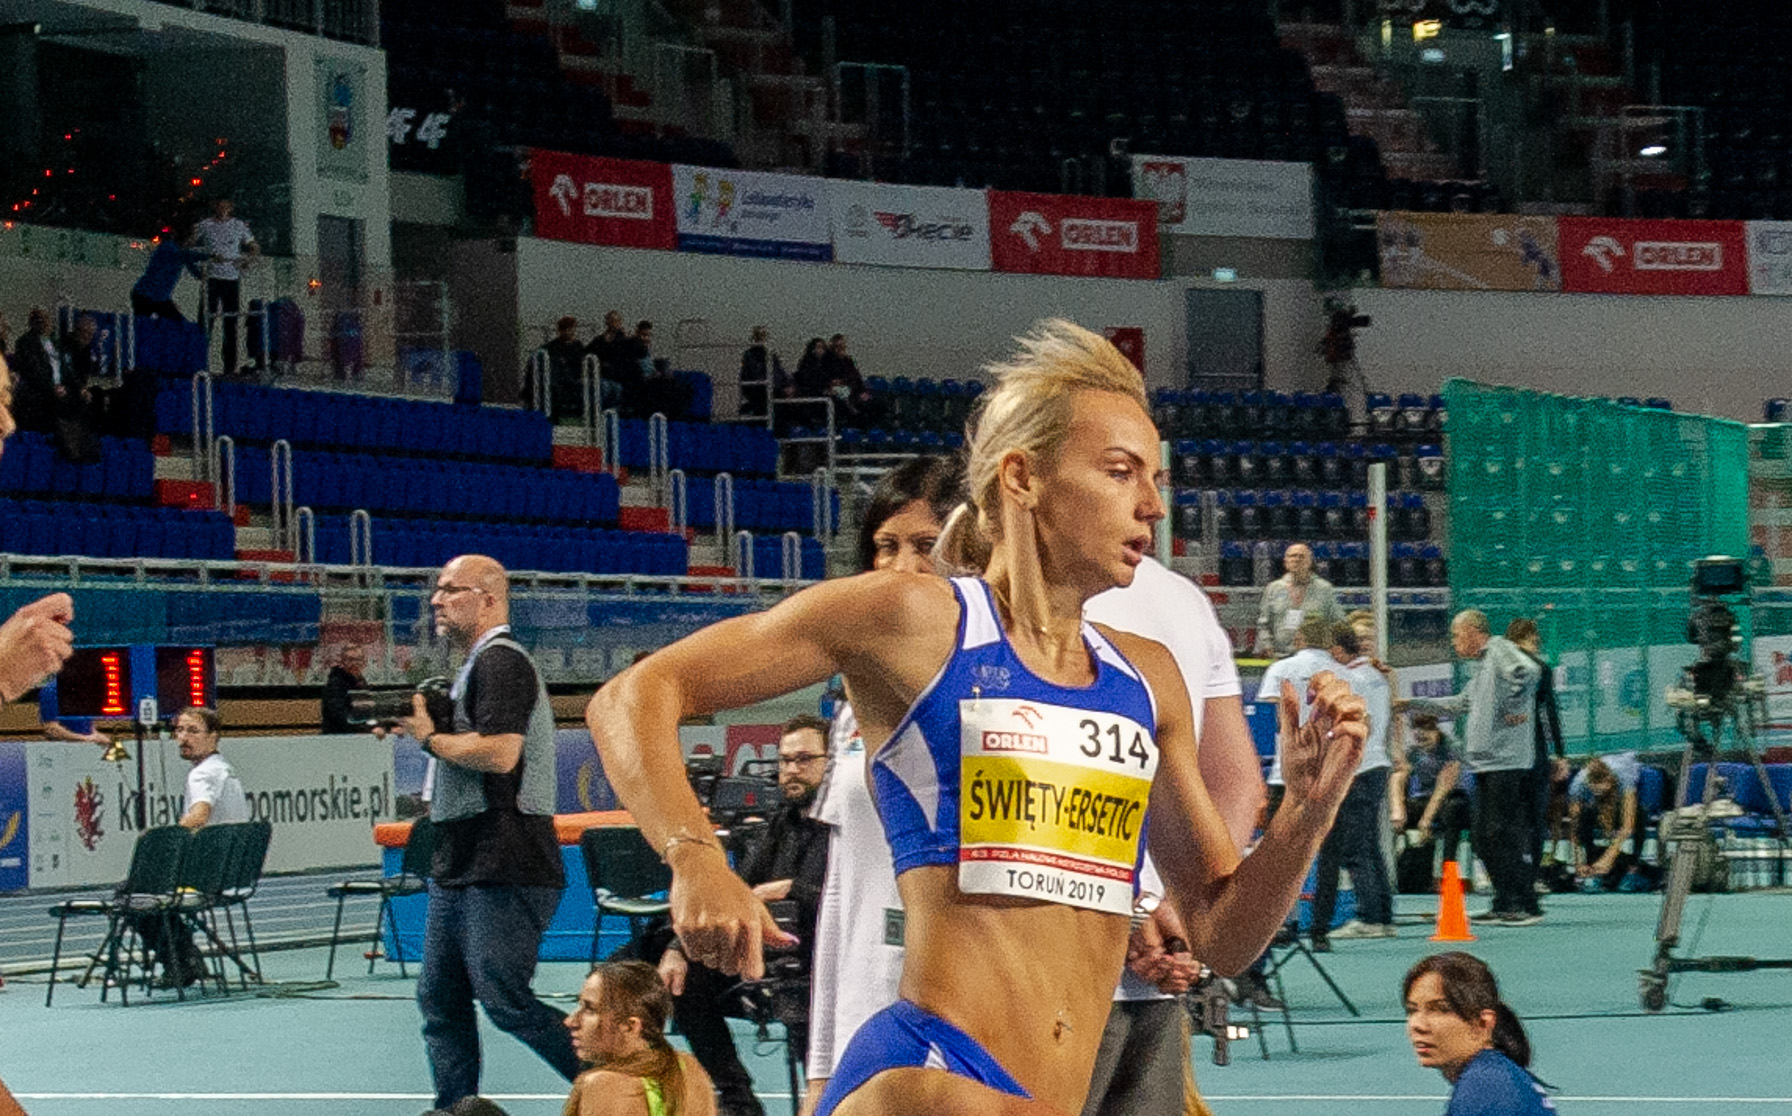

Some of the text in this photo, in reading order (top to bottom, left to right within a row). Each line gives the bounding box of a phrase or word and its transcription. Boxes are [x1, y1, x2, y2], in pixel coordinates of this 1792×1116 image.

[587, 187, 649, 214] ORLEN
[985, 733, 1046, 753] ORLEN
[1078, 718, 1150, 769] 314
[969, 769, 1140, 841] ŚWIĘTY-ERSETIC
[1006, 869, 1106, 903] TORUŃ 2019
